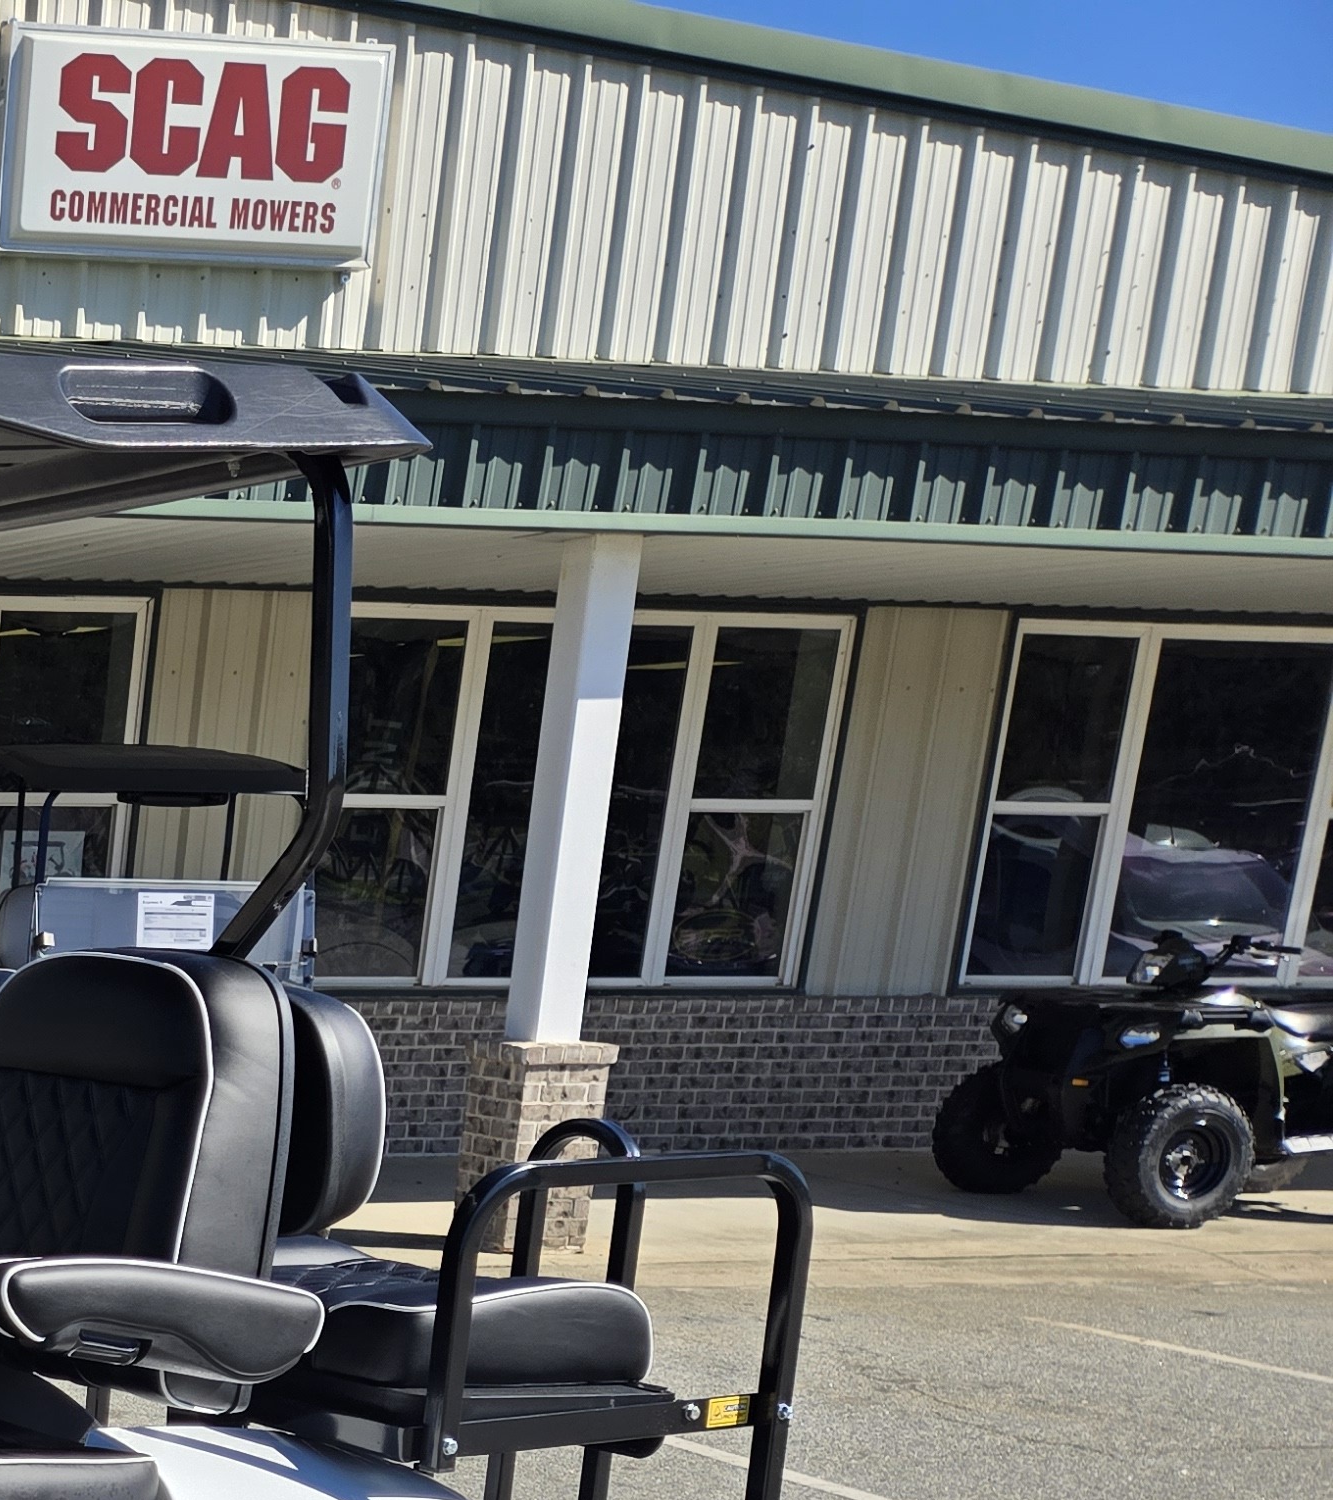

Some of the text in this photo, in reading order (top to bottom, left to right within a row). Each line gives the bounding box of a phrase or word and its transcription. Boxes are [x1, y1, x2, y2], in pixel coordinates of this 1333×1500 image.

[55, 53, 351, 184] SCAG
[50, 189, 337, 234] COMMERCIAL MOWERS
